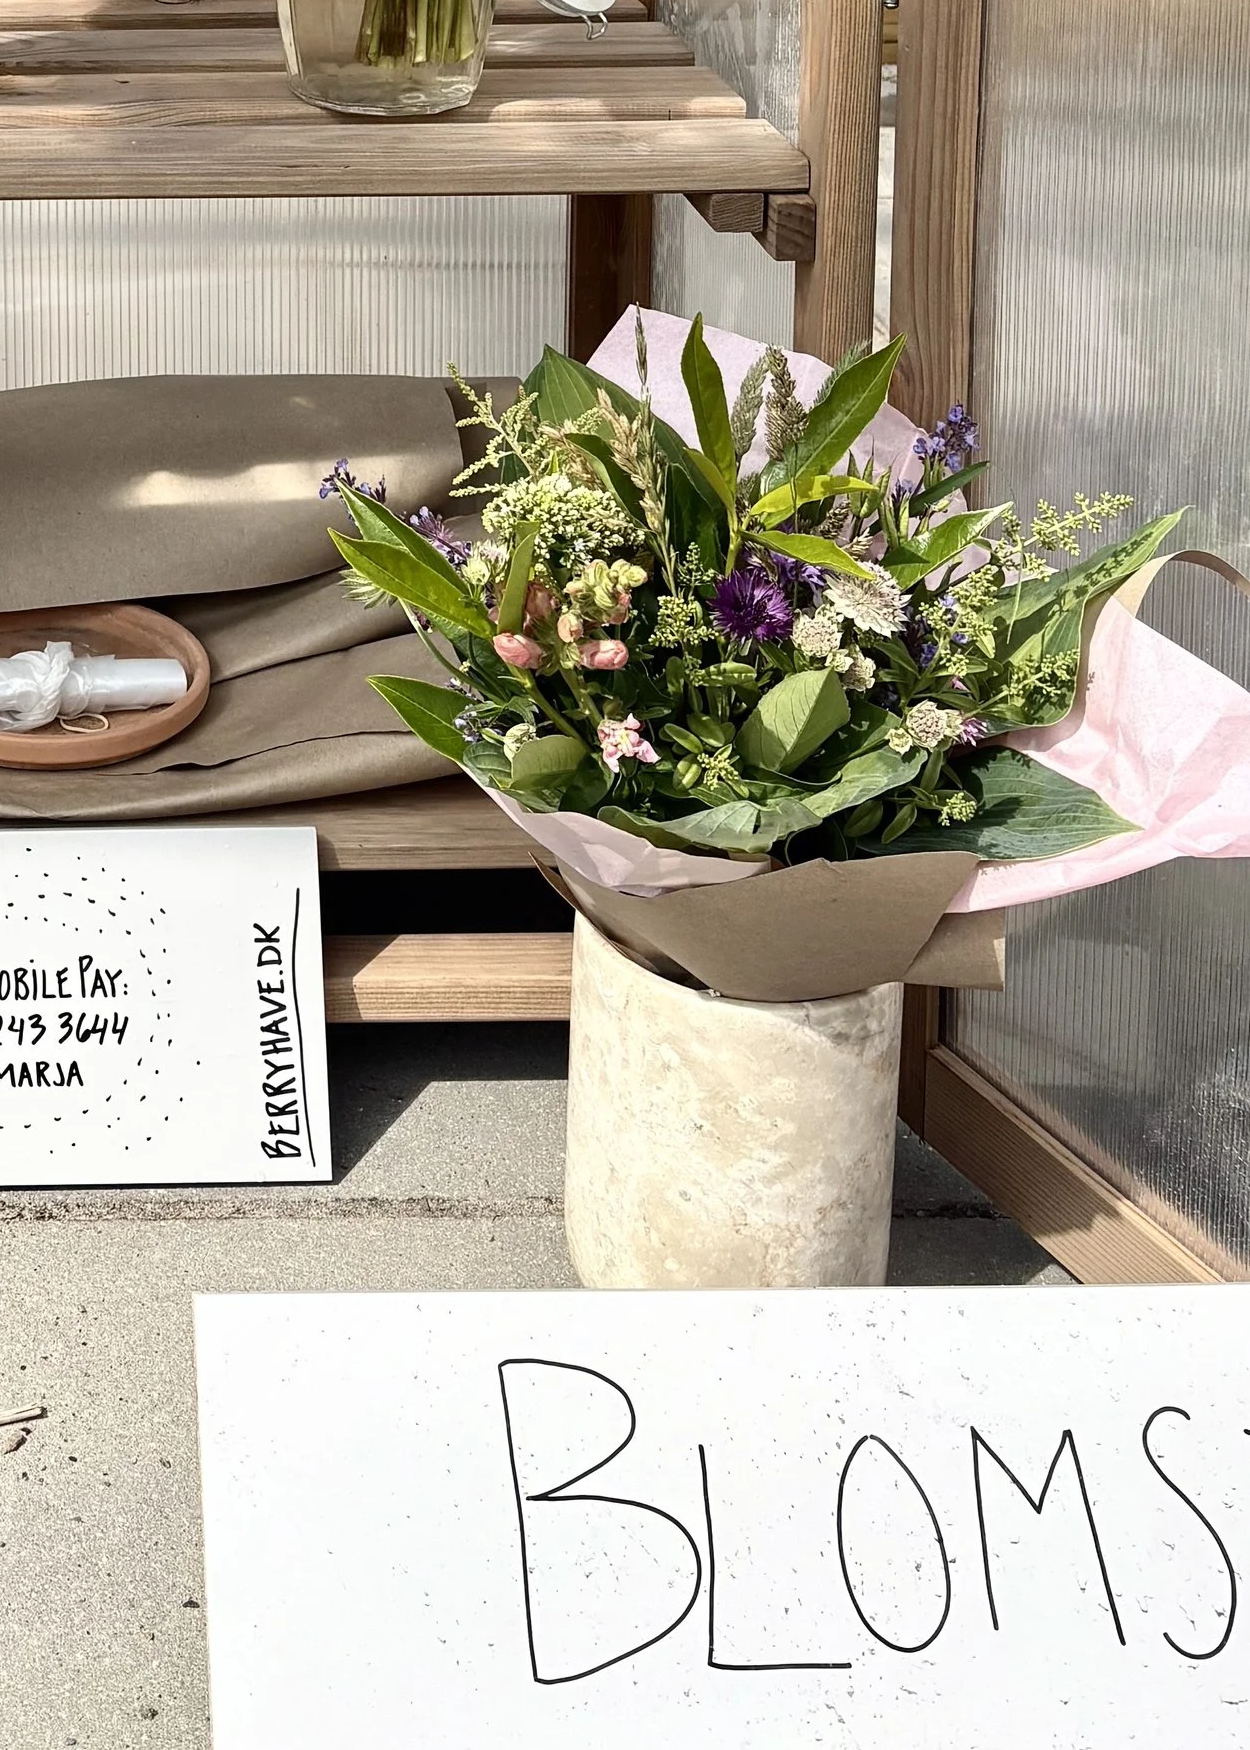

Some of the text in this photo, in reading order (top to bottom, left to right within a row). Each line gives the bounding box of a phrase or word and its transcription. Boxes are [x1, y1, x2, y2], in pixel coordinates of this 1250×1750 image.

[57, 1011, 129, 1046] 3644
[252, 922, 302, 1159] BERRYHAVE.DK
[498, 1357, 1250, 1685] BLOMS
